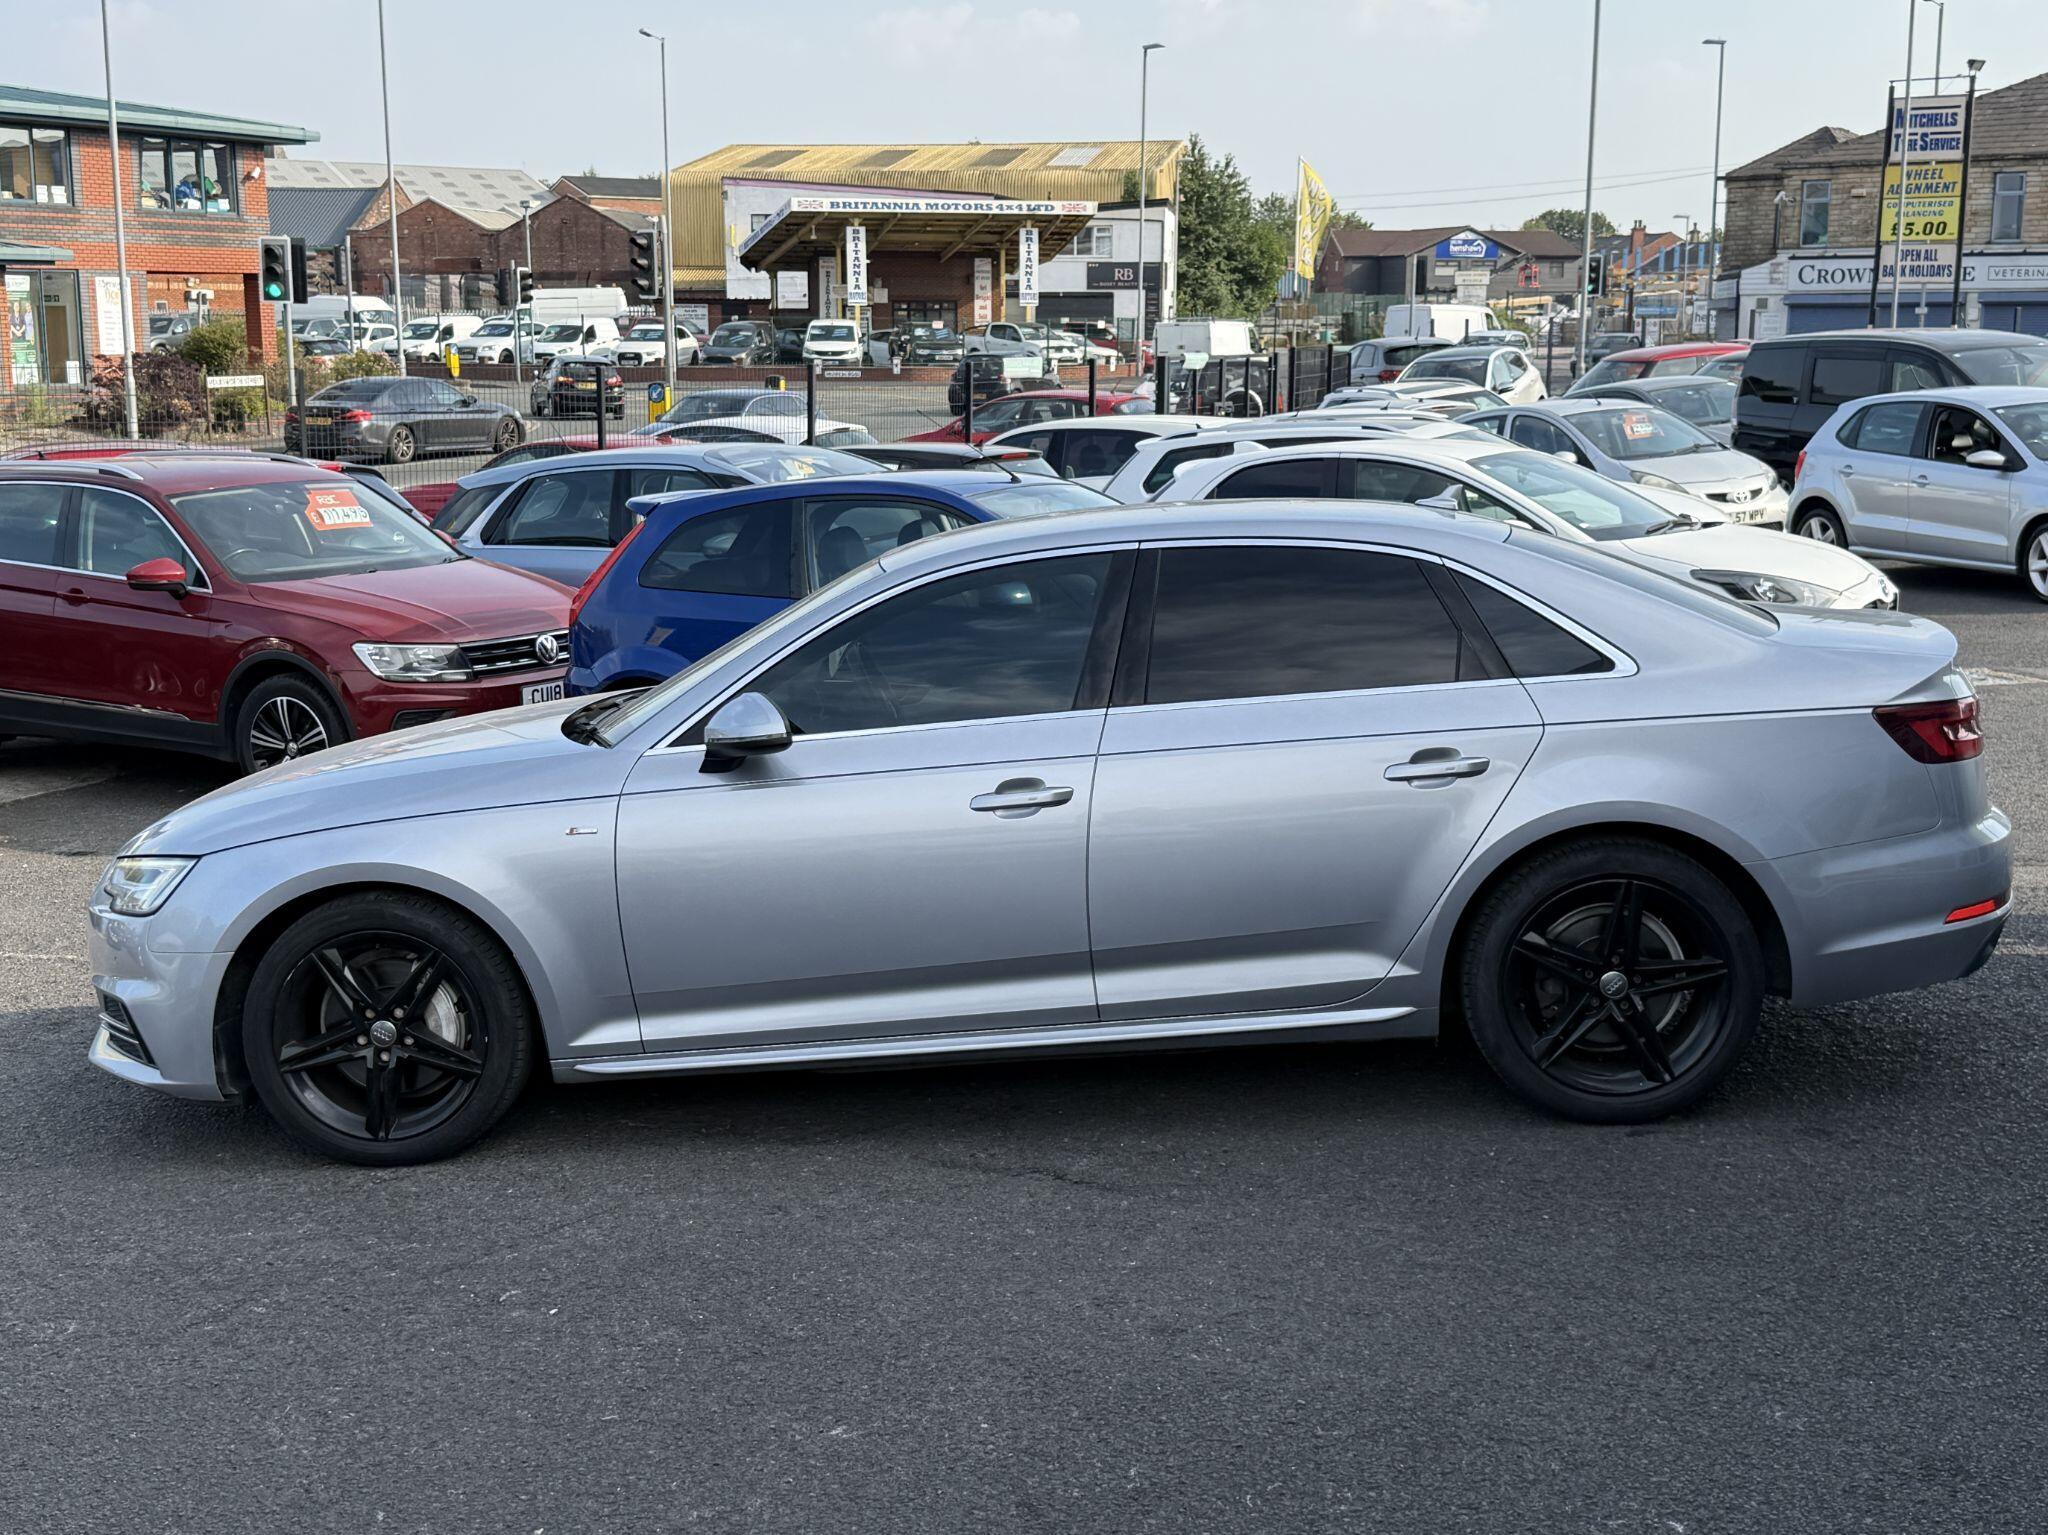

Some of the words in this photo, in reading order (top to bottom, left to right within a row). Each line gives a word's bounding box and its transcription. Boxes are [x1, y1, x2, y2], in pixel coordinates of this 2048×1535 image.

[1895, 108, 1958, 128] MITCHELLS
[1894, 133, 1917, 152] TRE
[1920, 132, 1961, 152] SERVICE
[1887, 181, 1958, 195] ALGNMENT
[830, 201, 921, 210] BRITANNIA
[925, 203, 993, 211] MOTORS
[995, 204, 1024, 212] 4x4
[1026, 204, 1056, 212] LTD
[1887, 200, 1954, 209] COPUTERISED
[1890, 221, 1948, 236] £5.00
[852, 229, 861, 290] BRITANNIA
[1025, 230, 1033, 290] BRITANNIA
[1923, 248, 1938, 261] ALL
[1114, 268, 1134, 281] RB
[1882, 264, 1907, 278] BAK
[1909, 264, 1953, 278] HOLIDAYS
[531, 685, 561, 703] CU18
